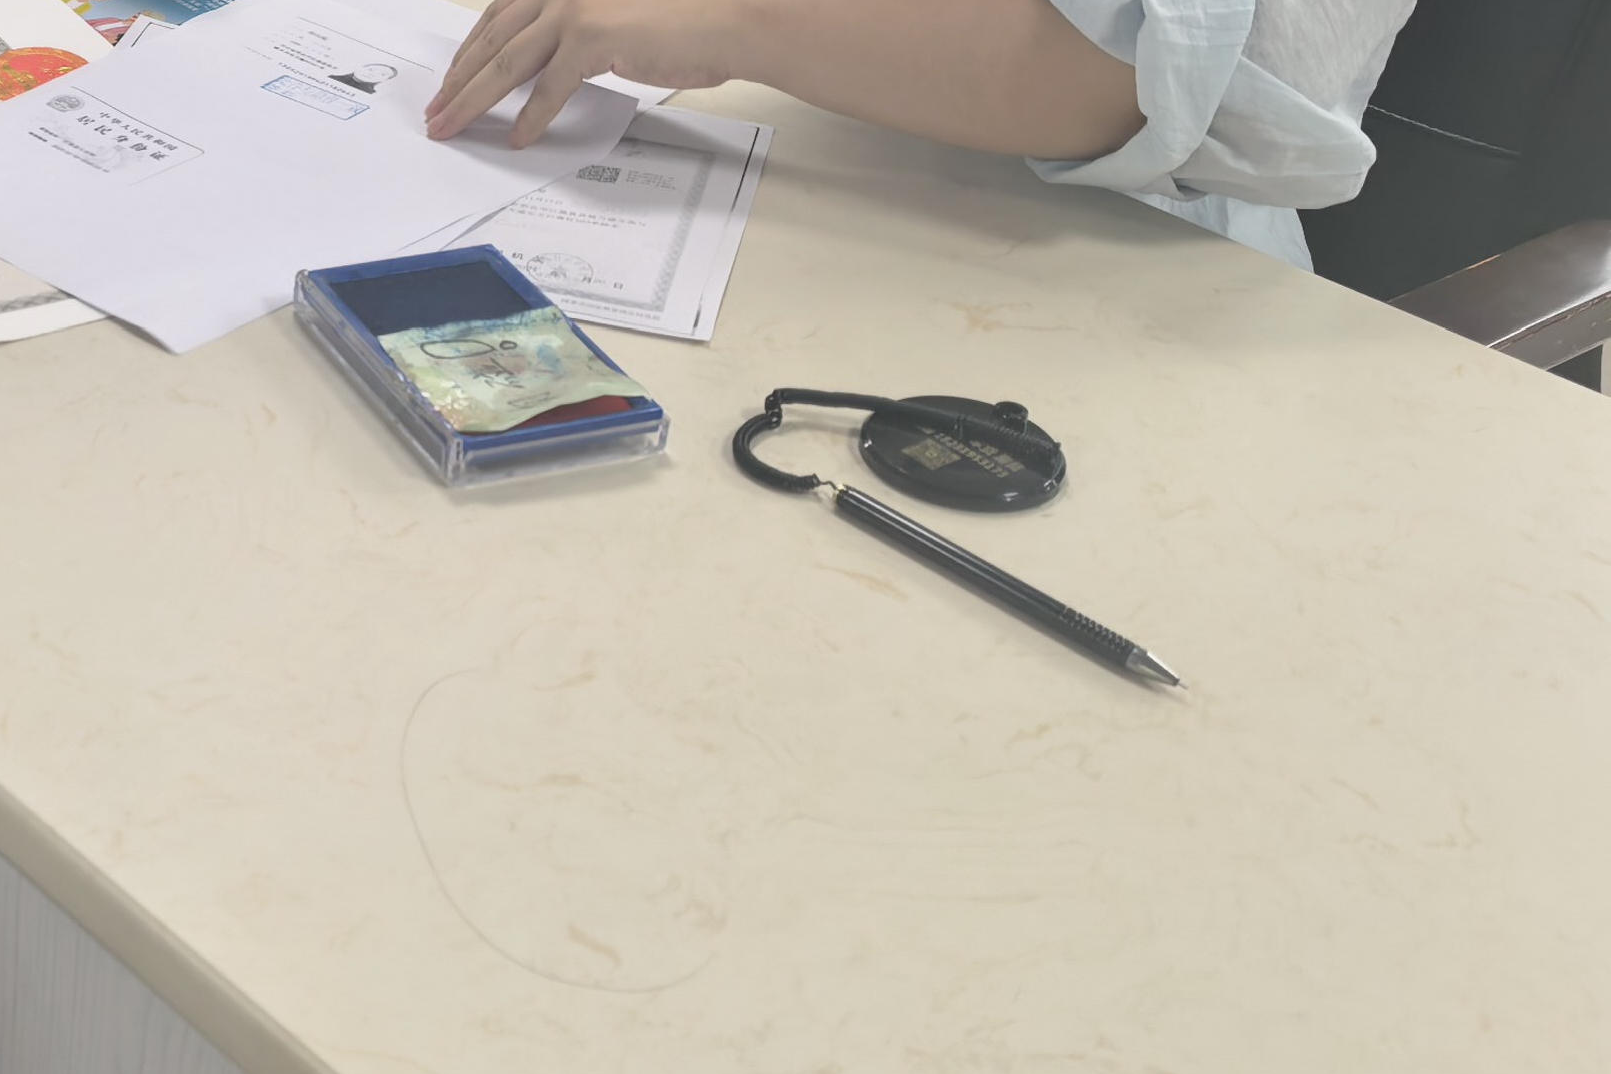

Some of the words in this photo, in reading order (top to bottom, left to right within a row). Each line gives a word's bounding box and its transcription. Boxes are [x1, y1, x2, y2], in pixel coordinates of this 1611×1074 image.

[76, 115, 169, 160] 居民身份证
[100, 112, 178, 150] 中华人民共和国
